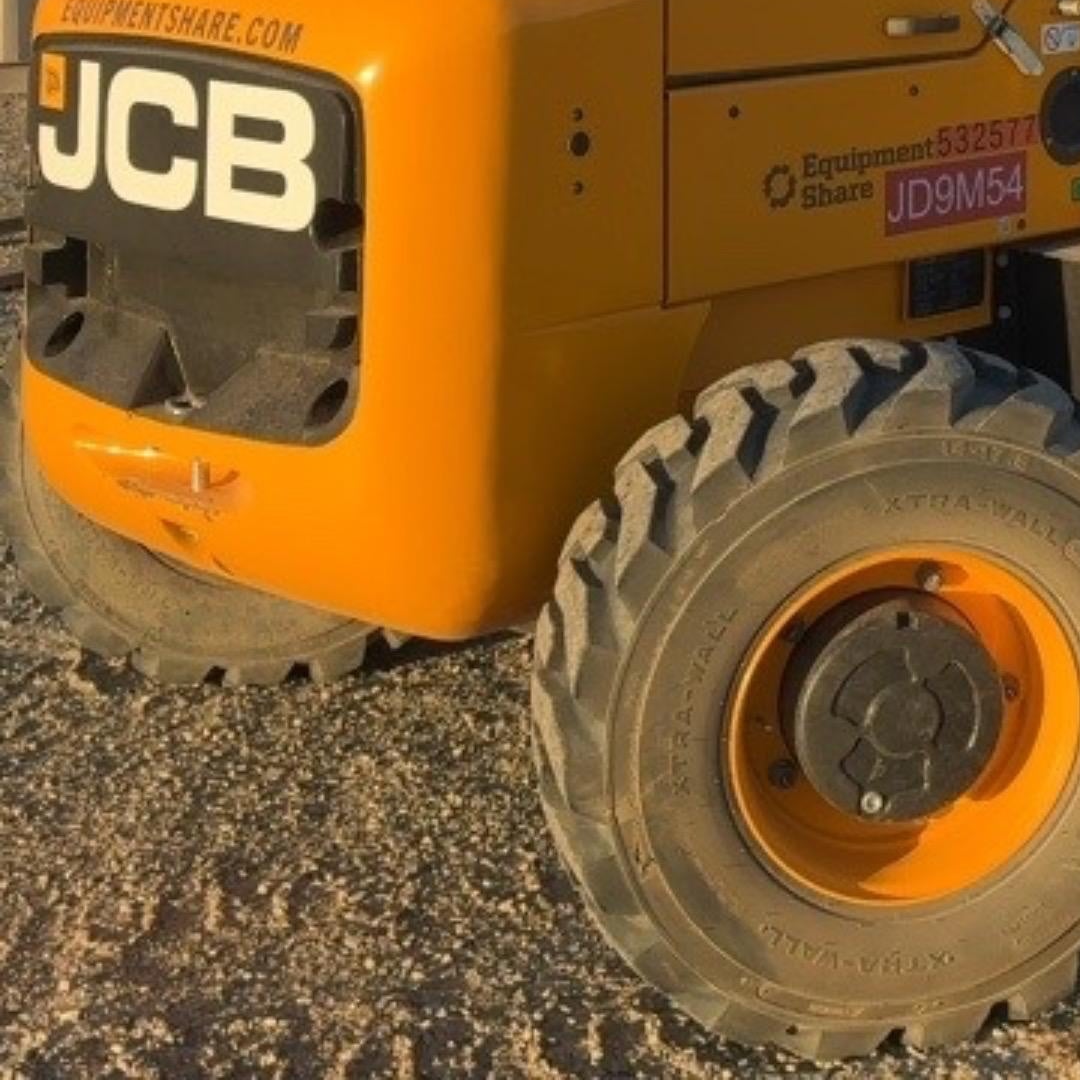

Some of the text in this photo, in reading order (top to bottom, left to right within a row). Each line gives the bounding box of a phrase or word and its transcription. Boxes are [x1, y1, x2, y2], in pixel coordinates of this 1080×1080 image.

[38, 59, 317, 233] JCB
[802, 136, 933, 178] Equipment
[937, 115, 1036, 157] 532577
[801, 181, 873, 210] Share
[888, 164, 1024, 224] JD9M54
